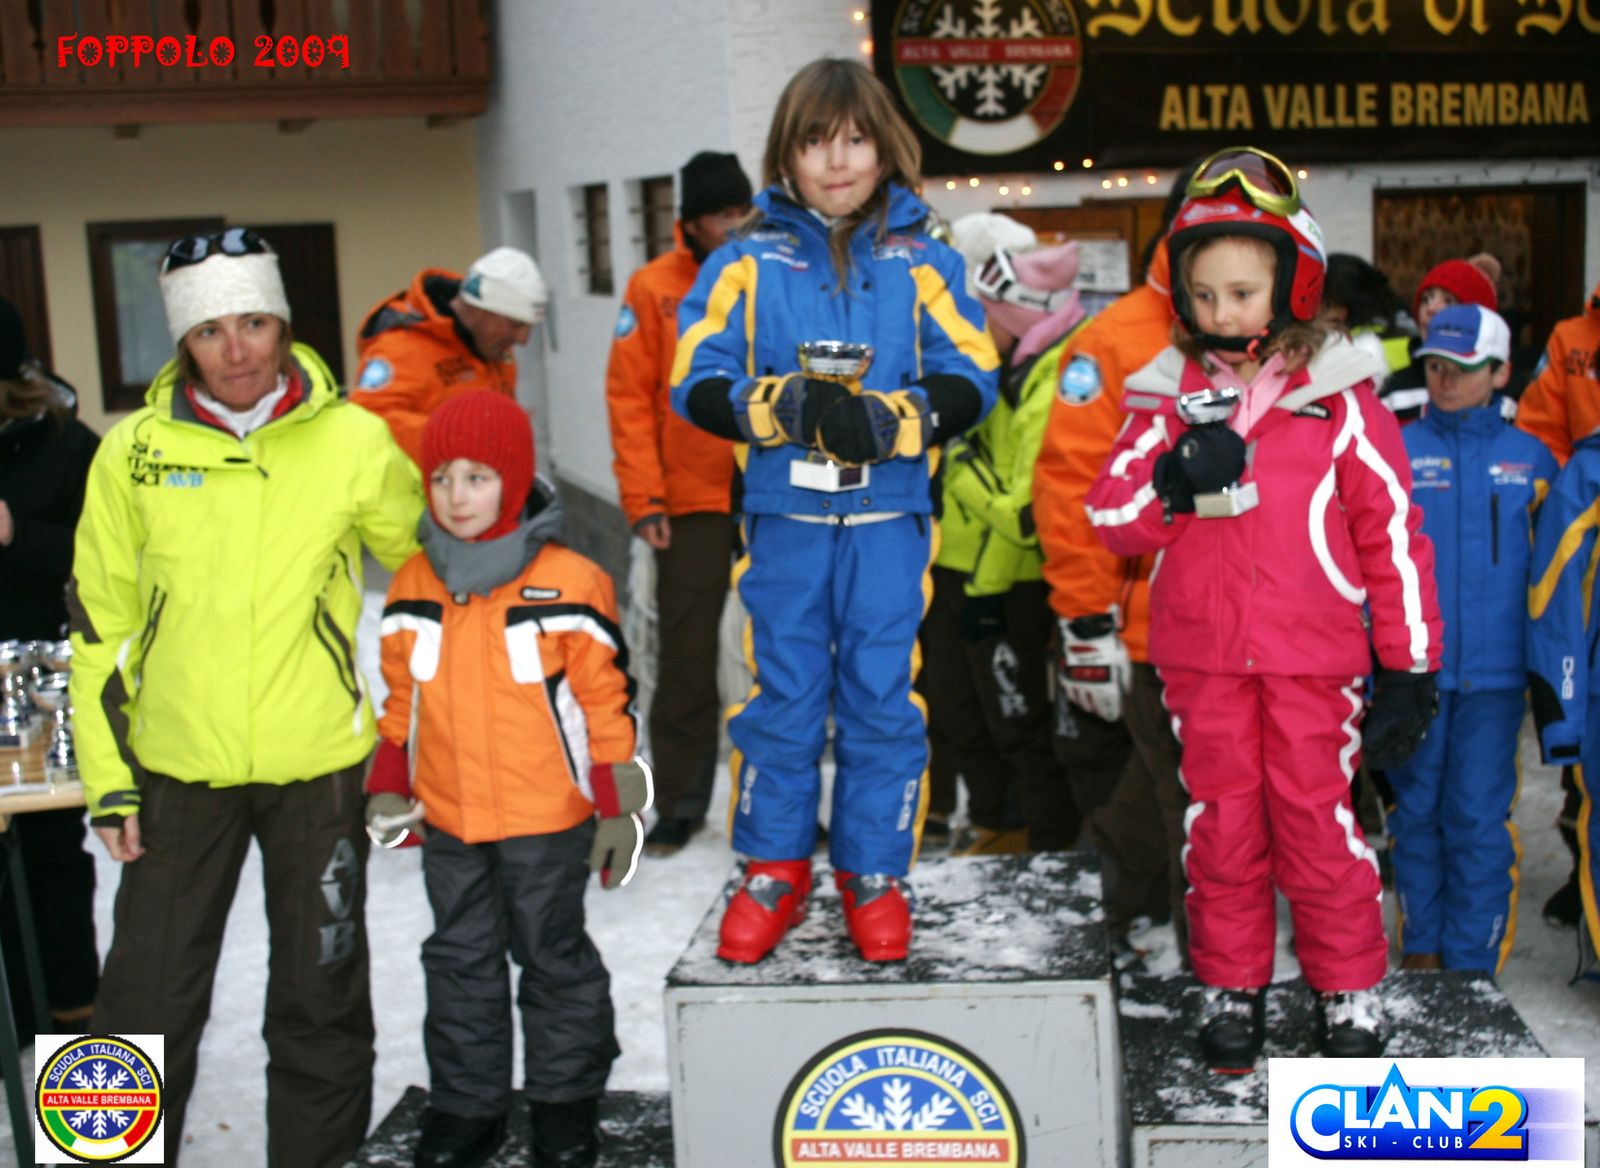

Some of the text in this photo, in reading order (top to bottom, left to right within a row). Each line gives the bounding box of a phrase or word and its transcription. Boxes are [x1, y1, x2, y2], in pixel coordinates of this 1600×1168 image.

[1159, 81, 1589, 131] ALTA VALLE BREMBANA
[801, 1047, 1001, 1124] SCUOLA ITALIANA SCI
[798, 1142, 1000, 1158] ALTA VALLE BREMBANA
